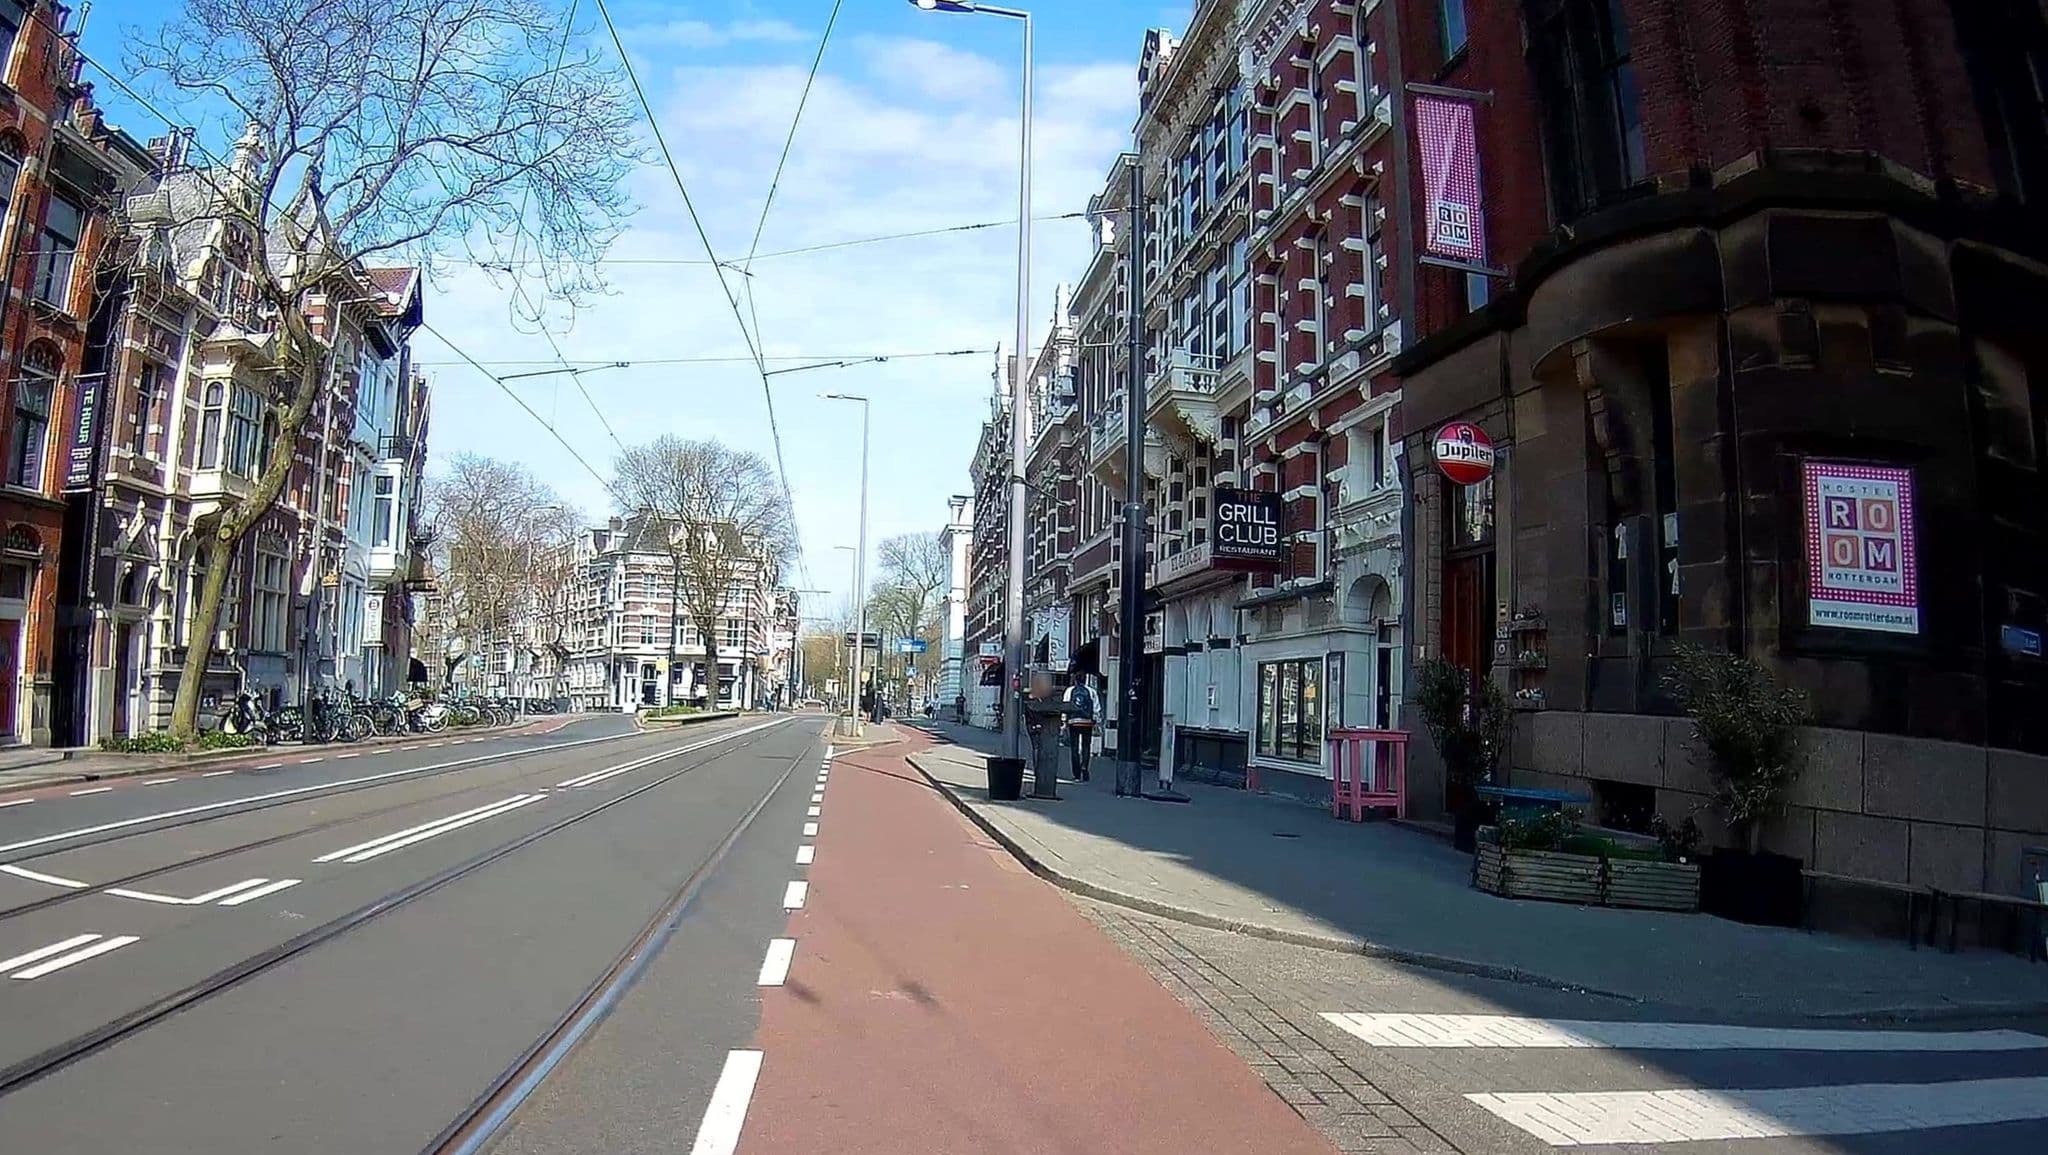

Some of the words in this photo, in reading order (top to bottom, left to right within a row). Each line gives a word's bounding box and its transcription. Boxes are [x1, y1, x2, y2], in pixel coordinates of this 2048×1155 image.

[83, 386, 95, 406] TE
[78, 406, 92, 444] HUUR
[1439, 442, 1492, 461] Jupiler
[1236, 491, 1262, 503] THE
[1822, 483, 1893, 497] HOSTEL
[1218, 503, 1277, 525] GRILL
[1218, 523, 1278, 545] CLUB
[1219, 545, 1277, 556] RESTAURANT
[1827, 572, 1898, 585] ROTTERDAM
[1815, 609, 1913, 626] www.roomrotterdam.nl
